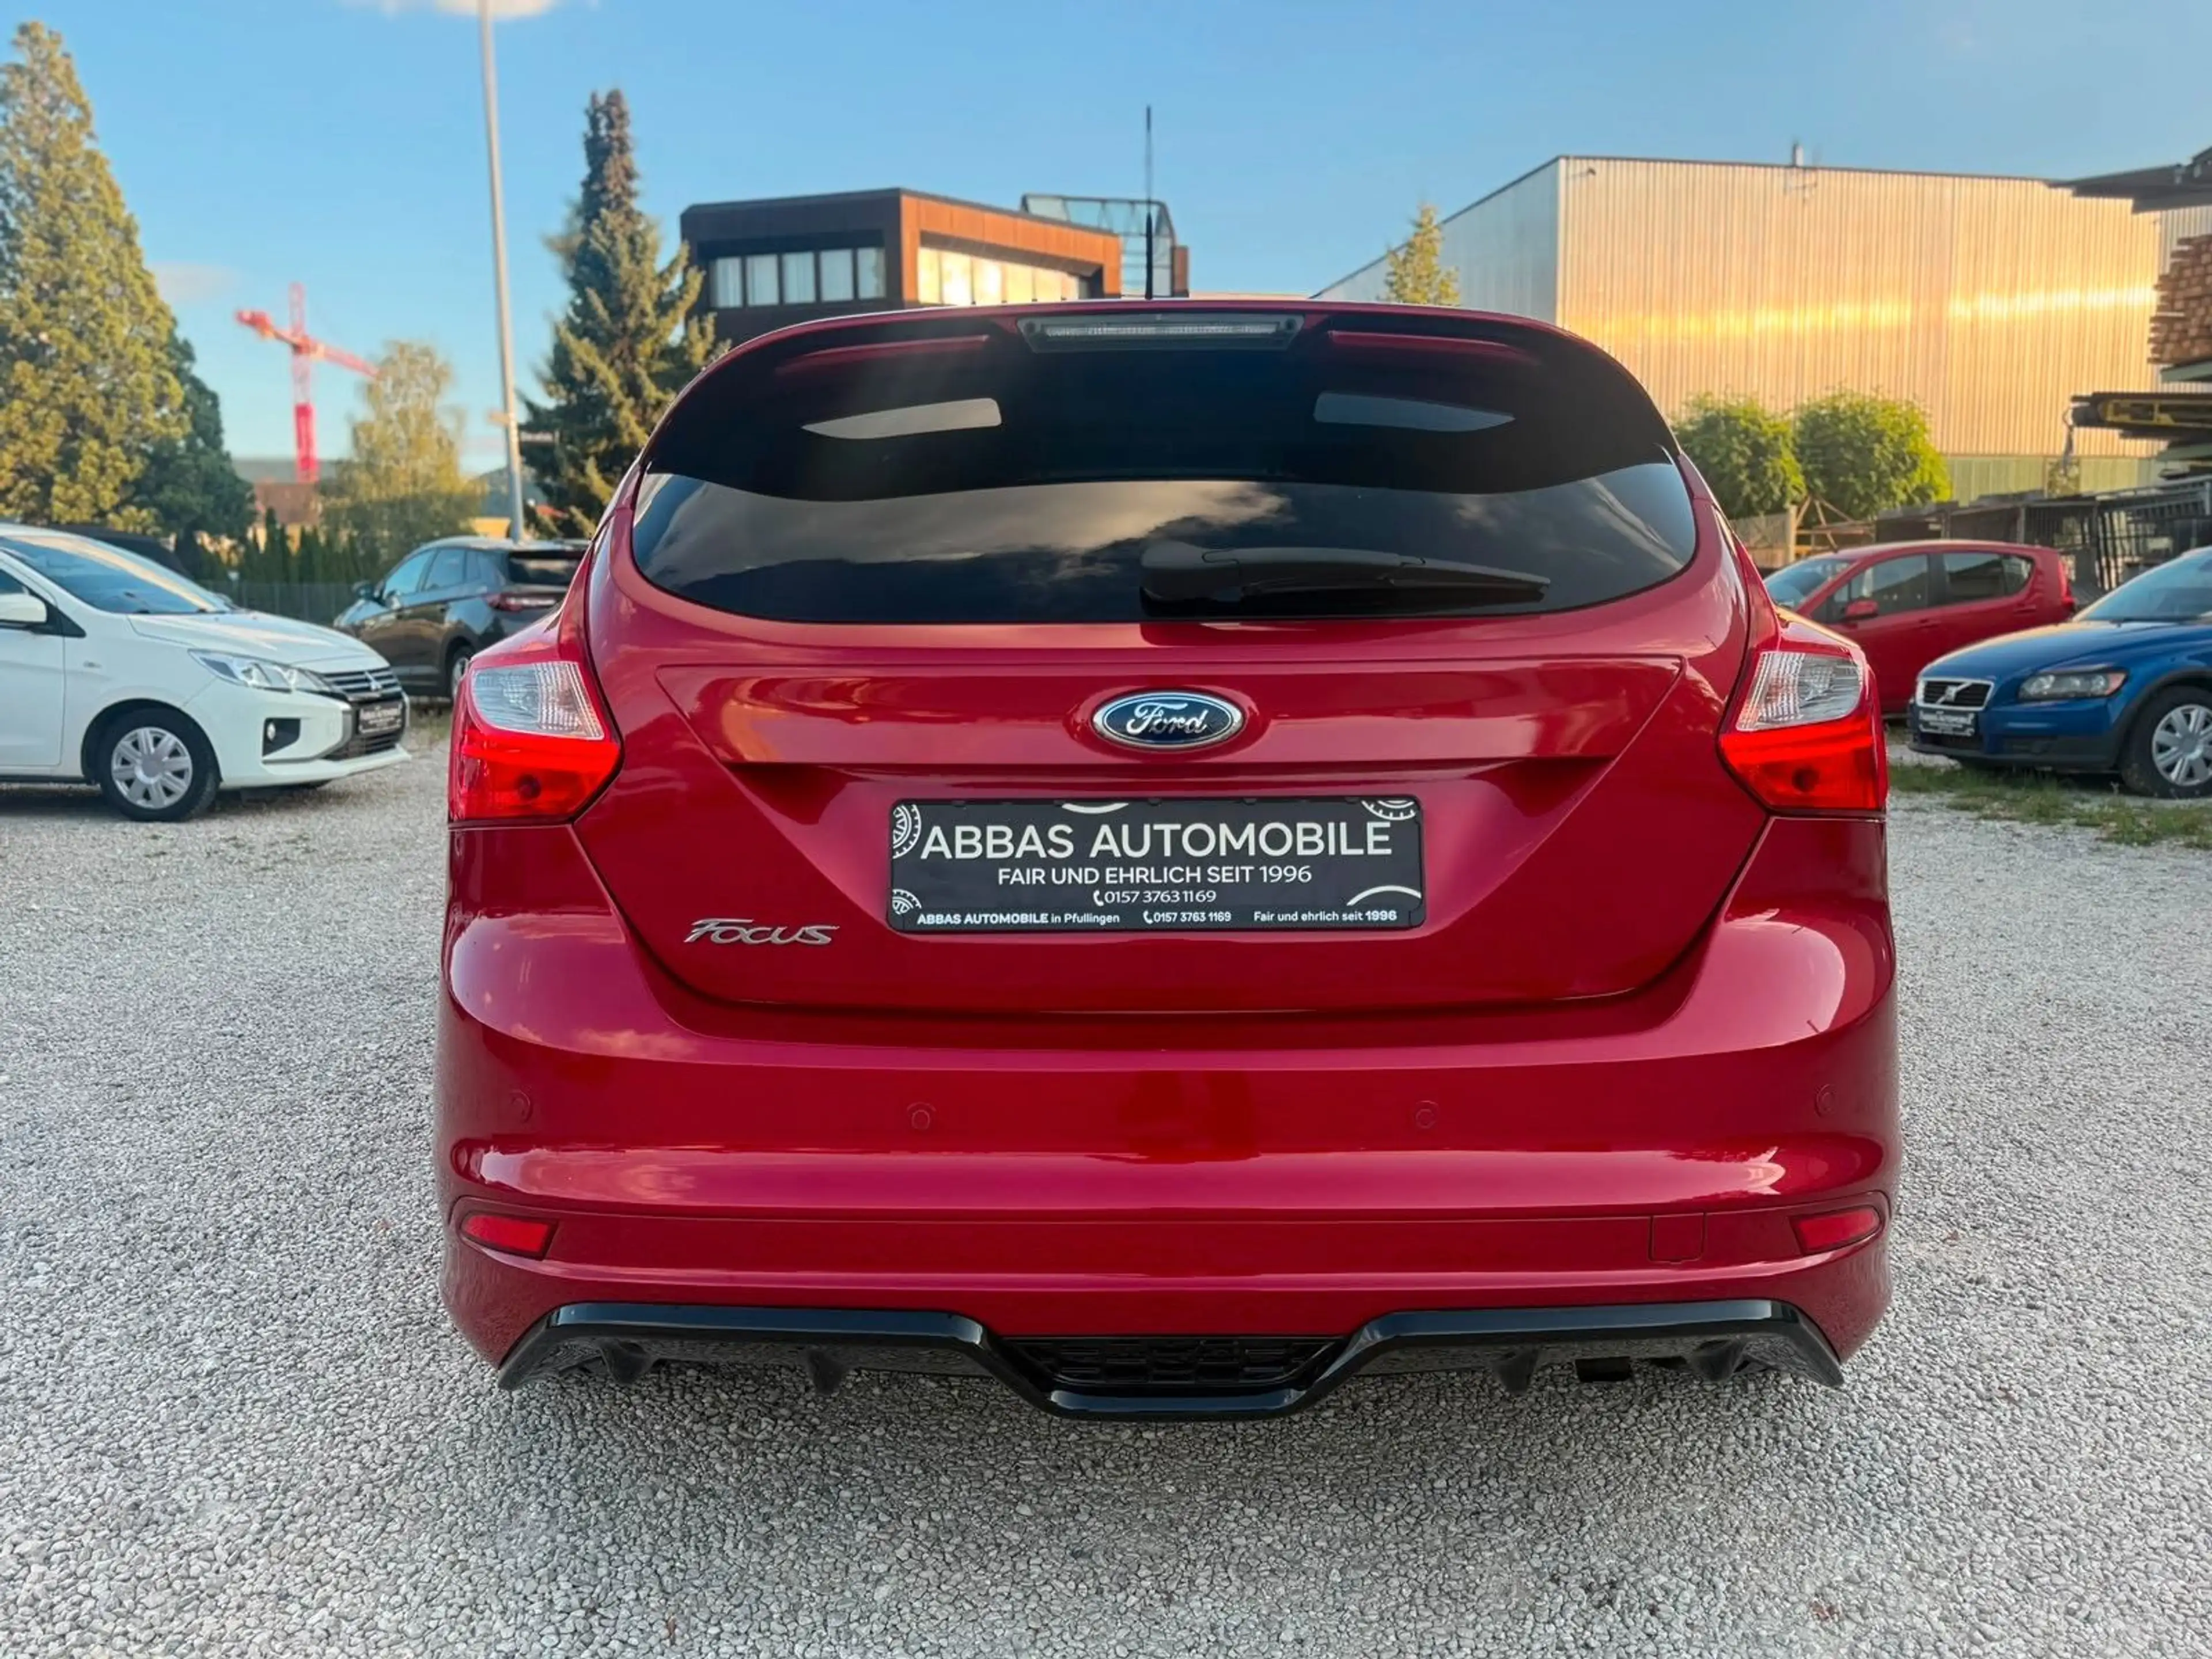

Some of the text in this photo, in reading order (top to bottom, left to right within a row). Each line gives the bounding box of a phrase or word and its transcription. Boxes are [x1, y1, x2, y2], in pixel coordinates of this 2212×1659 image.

[1126, 702, 1208, 736] Ford
[921, 821, 1392, 859] ABBAS AUTOMOBILE
[998, 865, 1312, 885] FAIR UND EHRLICH SEIT 1996
[1104, 889, 1217, 904] 0157 3763 1169
[917, 912, 1120, 926] ABBAS AUTOMOBILE in Pfullingen
[1153, 911, 1232, 923] 0157 3763 1169
[1253, 911, 1275, 922] Fair
[1277, 911, 1299, 922] und
[1301, 910, 1340, 922] ehrlich
[1342, 910, 1364, 922] seit
